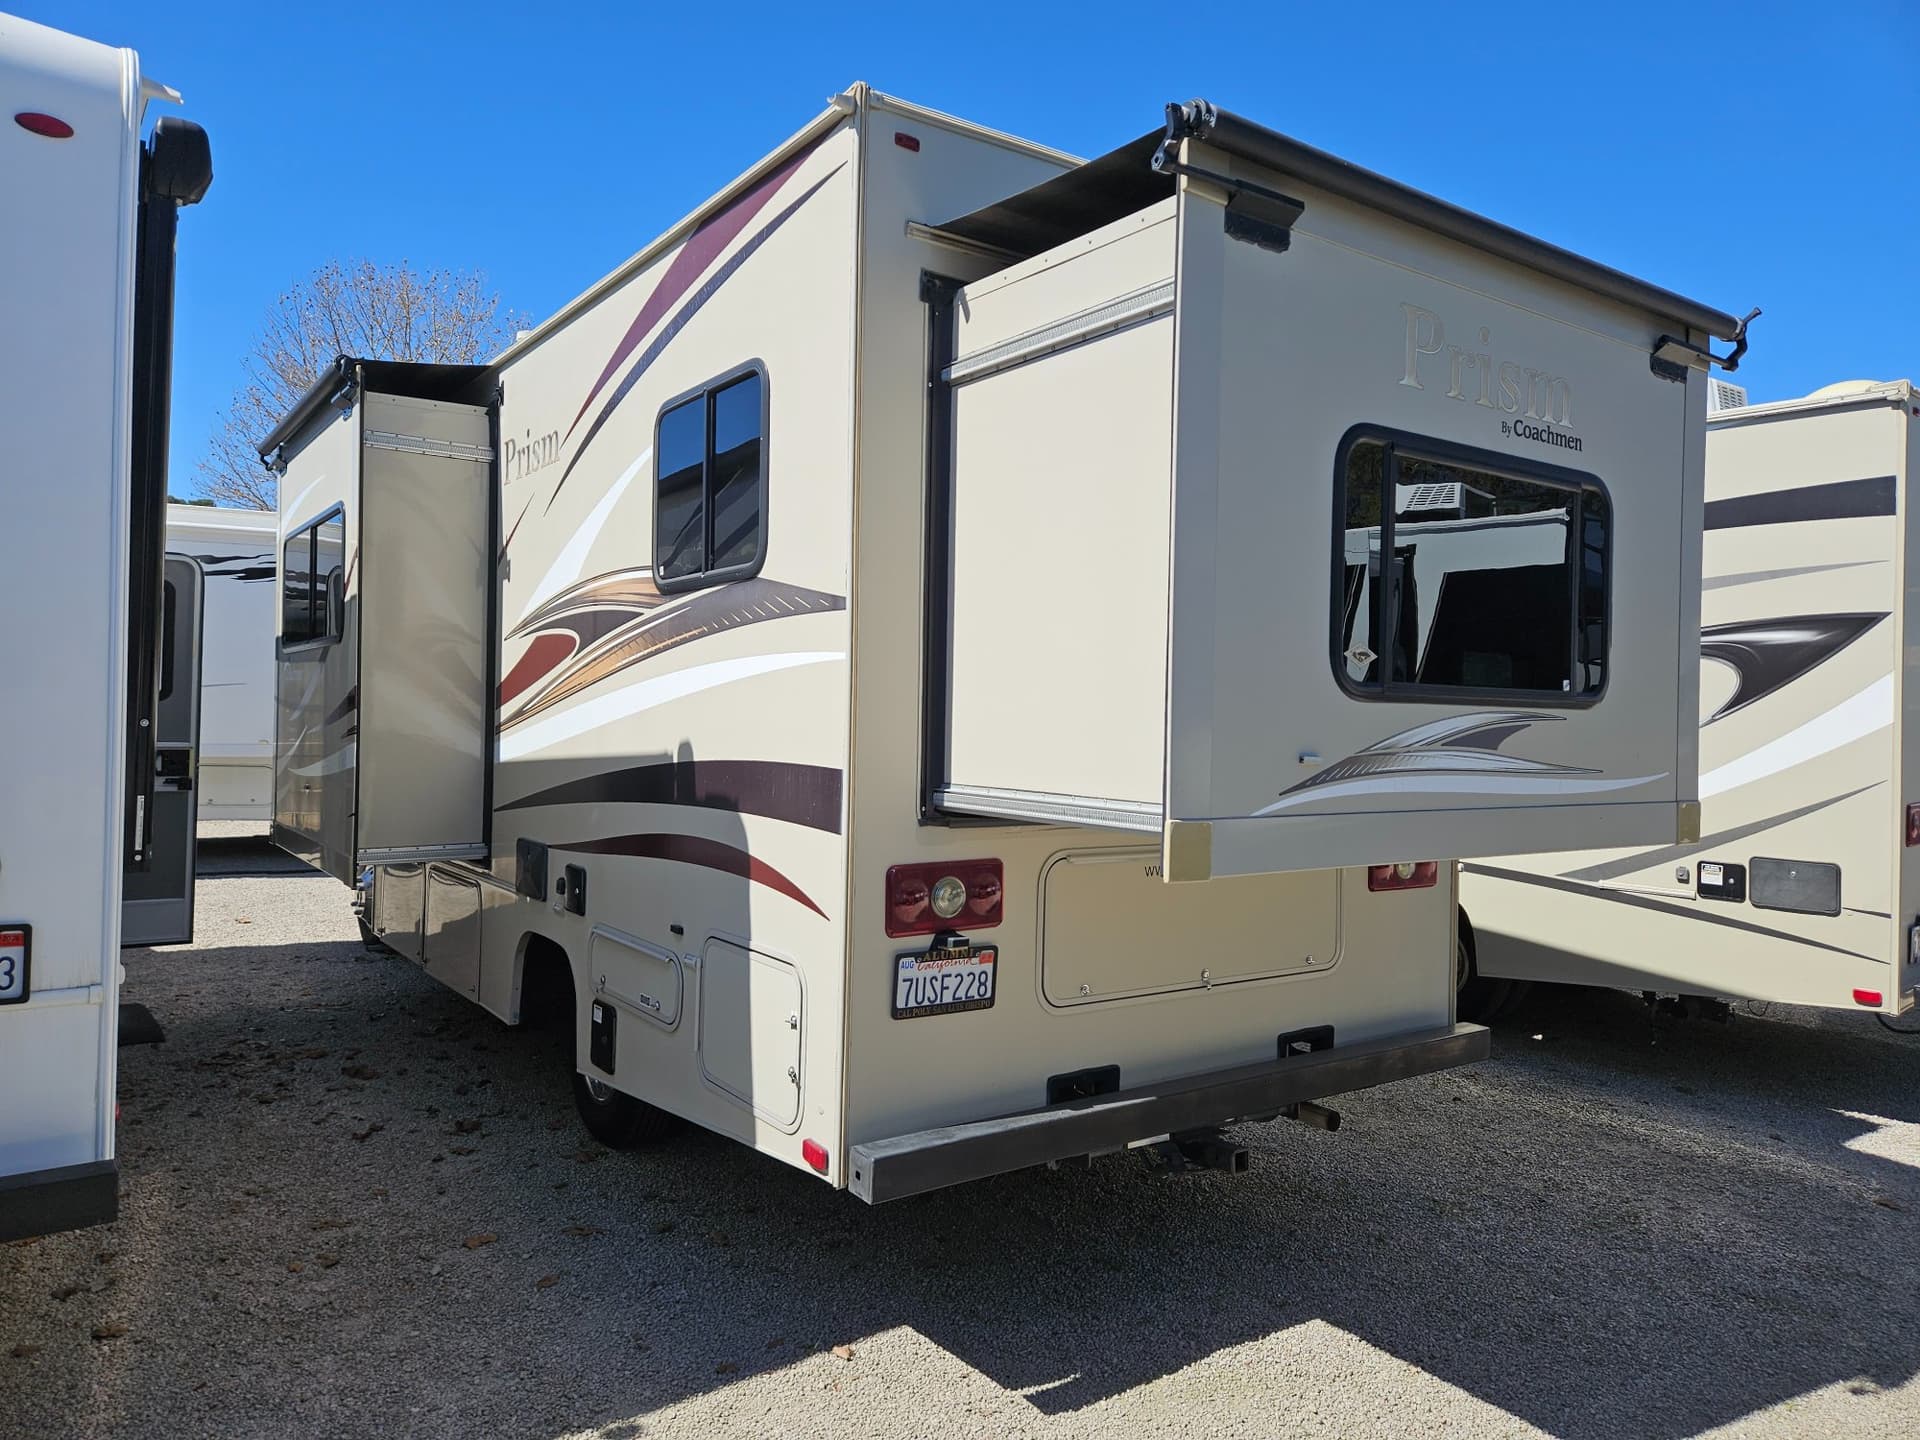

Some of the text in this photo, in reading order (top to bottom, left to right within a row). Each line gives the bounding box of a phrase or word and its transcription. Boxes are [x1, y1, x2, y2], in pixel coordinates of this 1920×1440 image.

[1398, 302, 1574, 429] Prism
[1501, 419, 1583, 451] By Coachmen
[504, 428, 560, 486] Prism
[901, 960, 914, 969] AUG
[902, 971, 988, 1007] 7USF228
